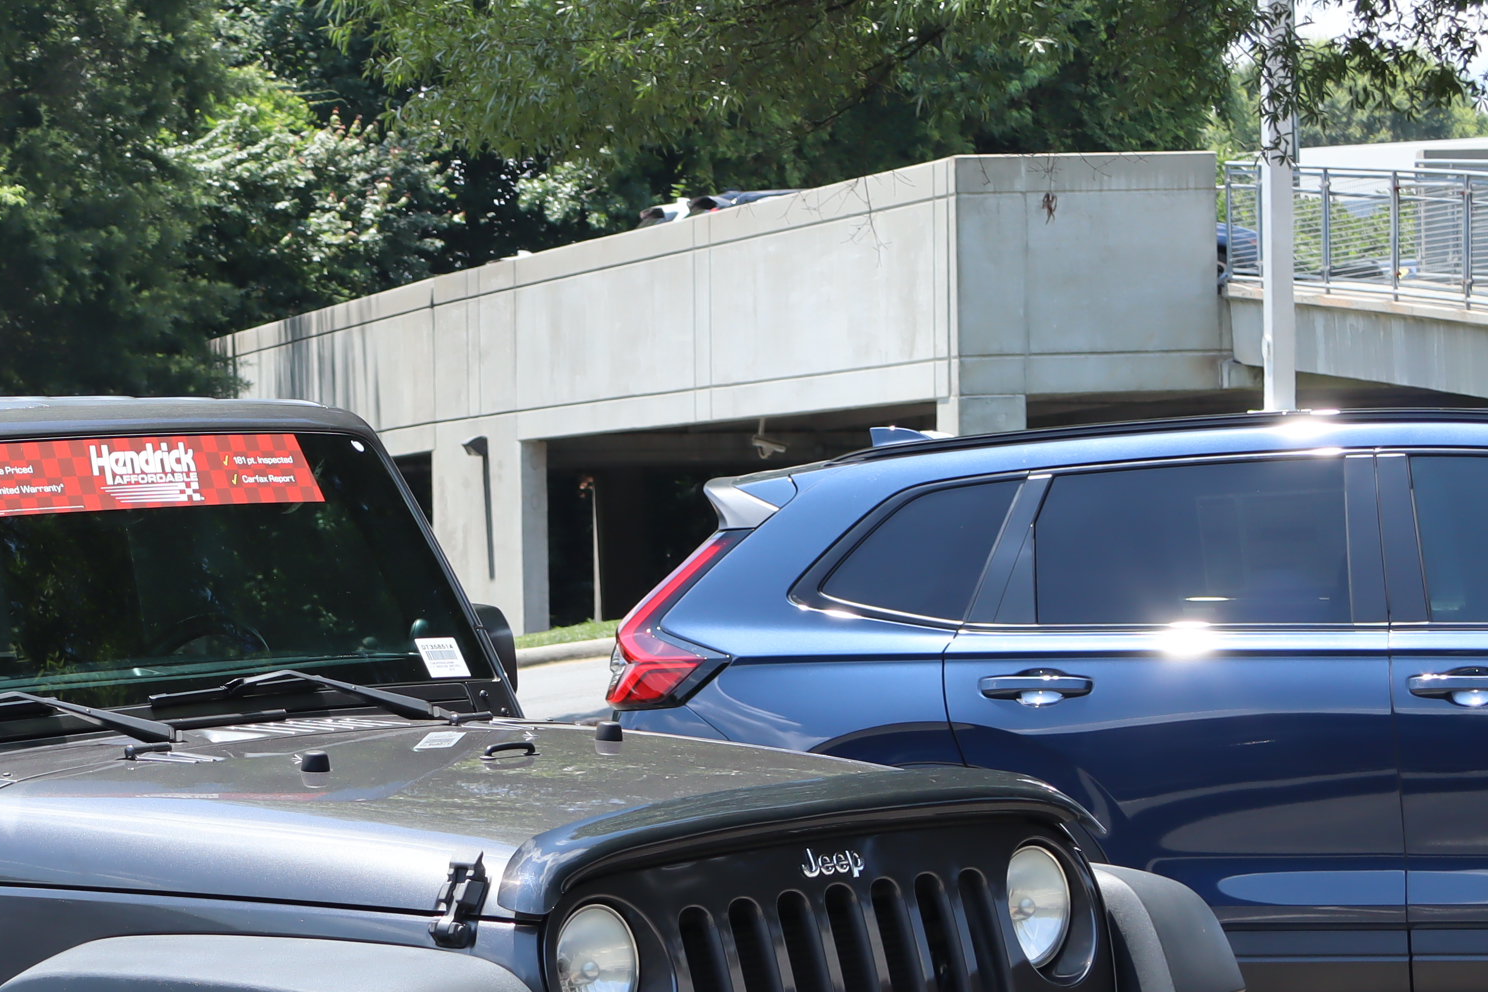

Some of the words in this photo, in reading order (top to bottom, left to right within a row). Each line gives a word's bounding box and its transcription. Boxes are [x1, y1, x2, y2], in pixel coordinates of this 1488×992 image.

[89, 441, 197, 485] Hendrick
[233, 456, 247, 464] 181
[257, 455, 294, 465] Inspected
[4, 465, 34, 475] Priced
[114, 472, 199, 485] AFFORDABLE
[241, 474, 269, 483] Carfax
[268, 474, 295, 484] Report
[801, 848, 865, 878] Jeep
